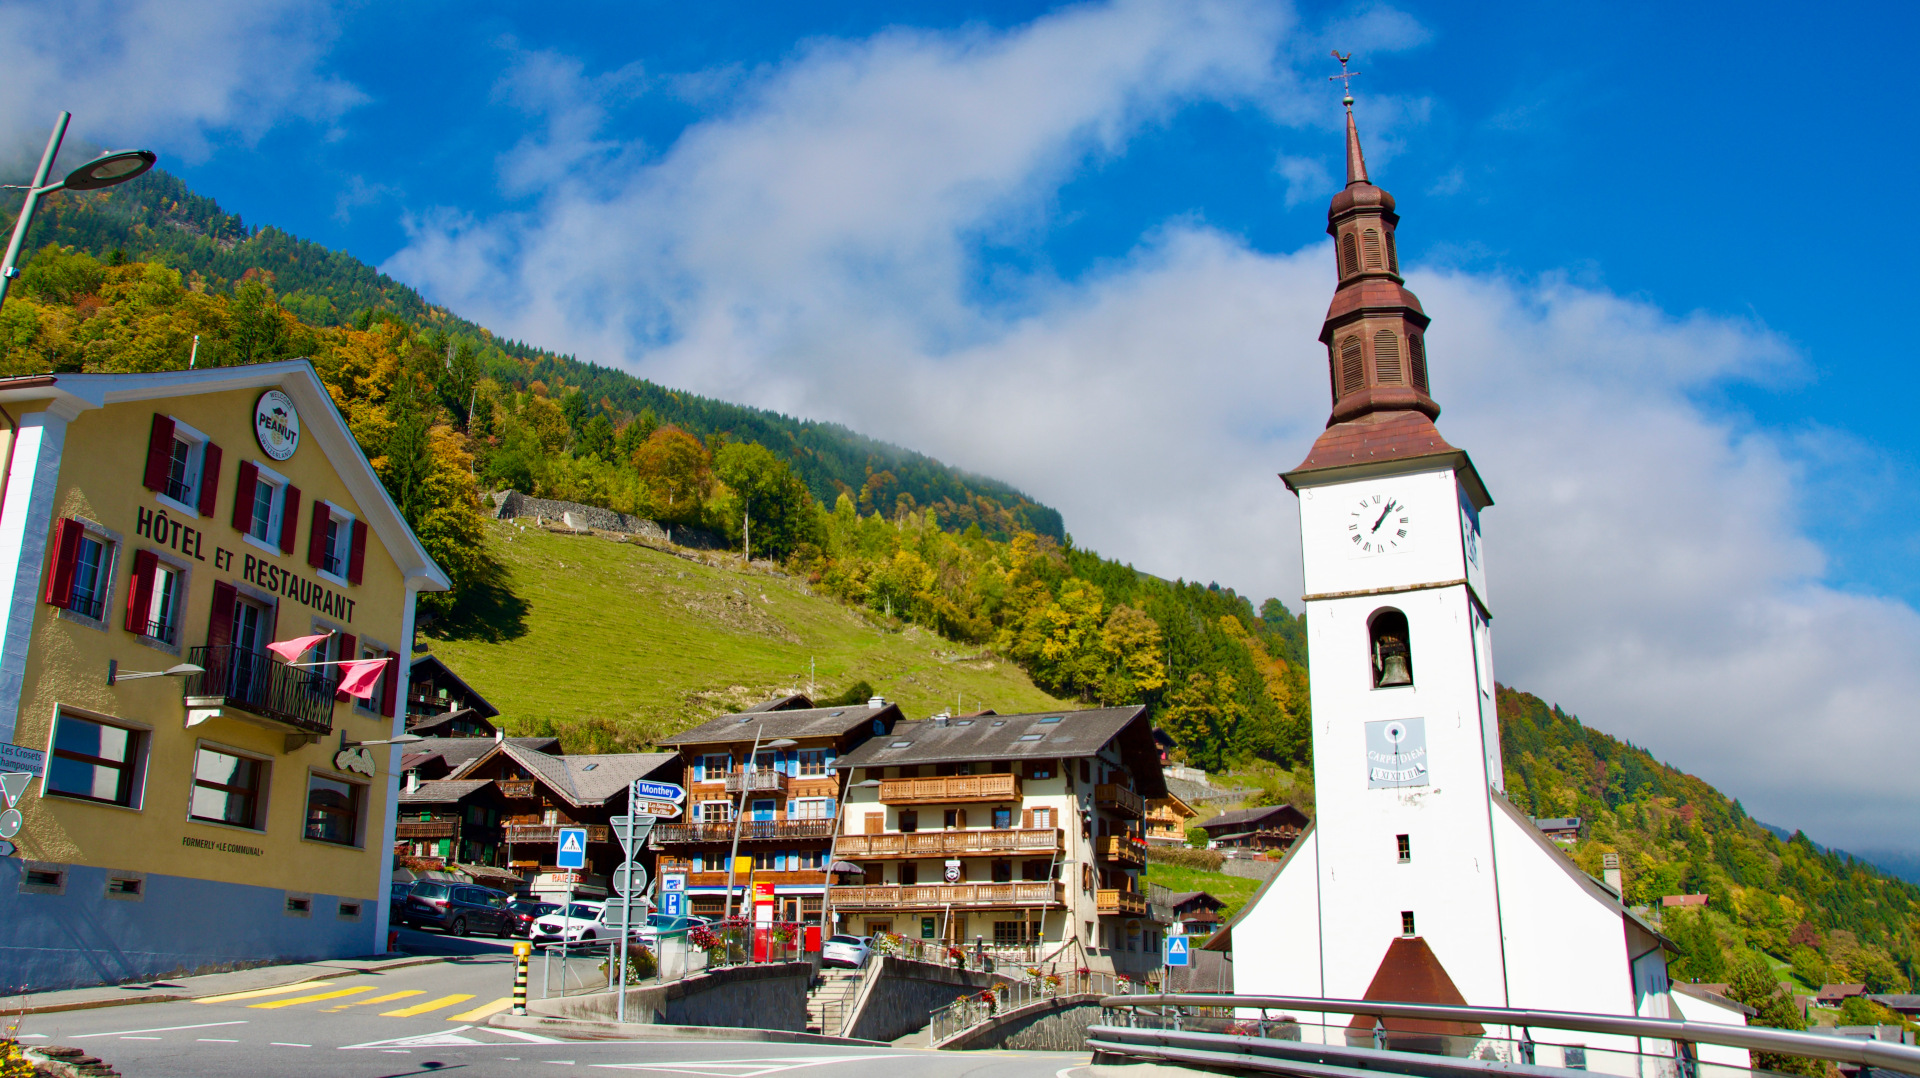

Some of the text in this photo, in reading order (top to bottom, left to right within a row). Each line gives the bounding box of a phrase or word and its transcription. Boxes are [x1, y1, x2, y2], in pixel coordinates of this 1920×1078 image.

[269, 391, 293, 410] WELCOME
[258, 412, 297, 445] PEANUT
[260, 432, 292, 459] SWITZERLAND
[136, 506, 356, 623] HÔTEL ET RESTAURANT
[2, 744, 42, 762] Les Crosets
[1368, 745, 1426, 764] CARPE DIEM
[0, 756, 44, 773] hampoussin
[641, 783, 674, 798] Monthey
[182, 836, 216, 850] FORMERLY
[668, 894, 677, 906] P
